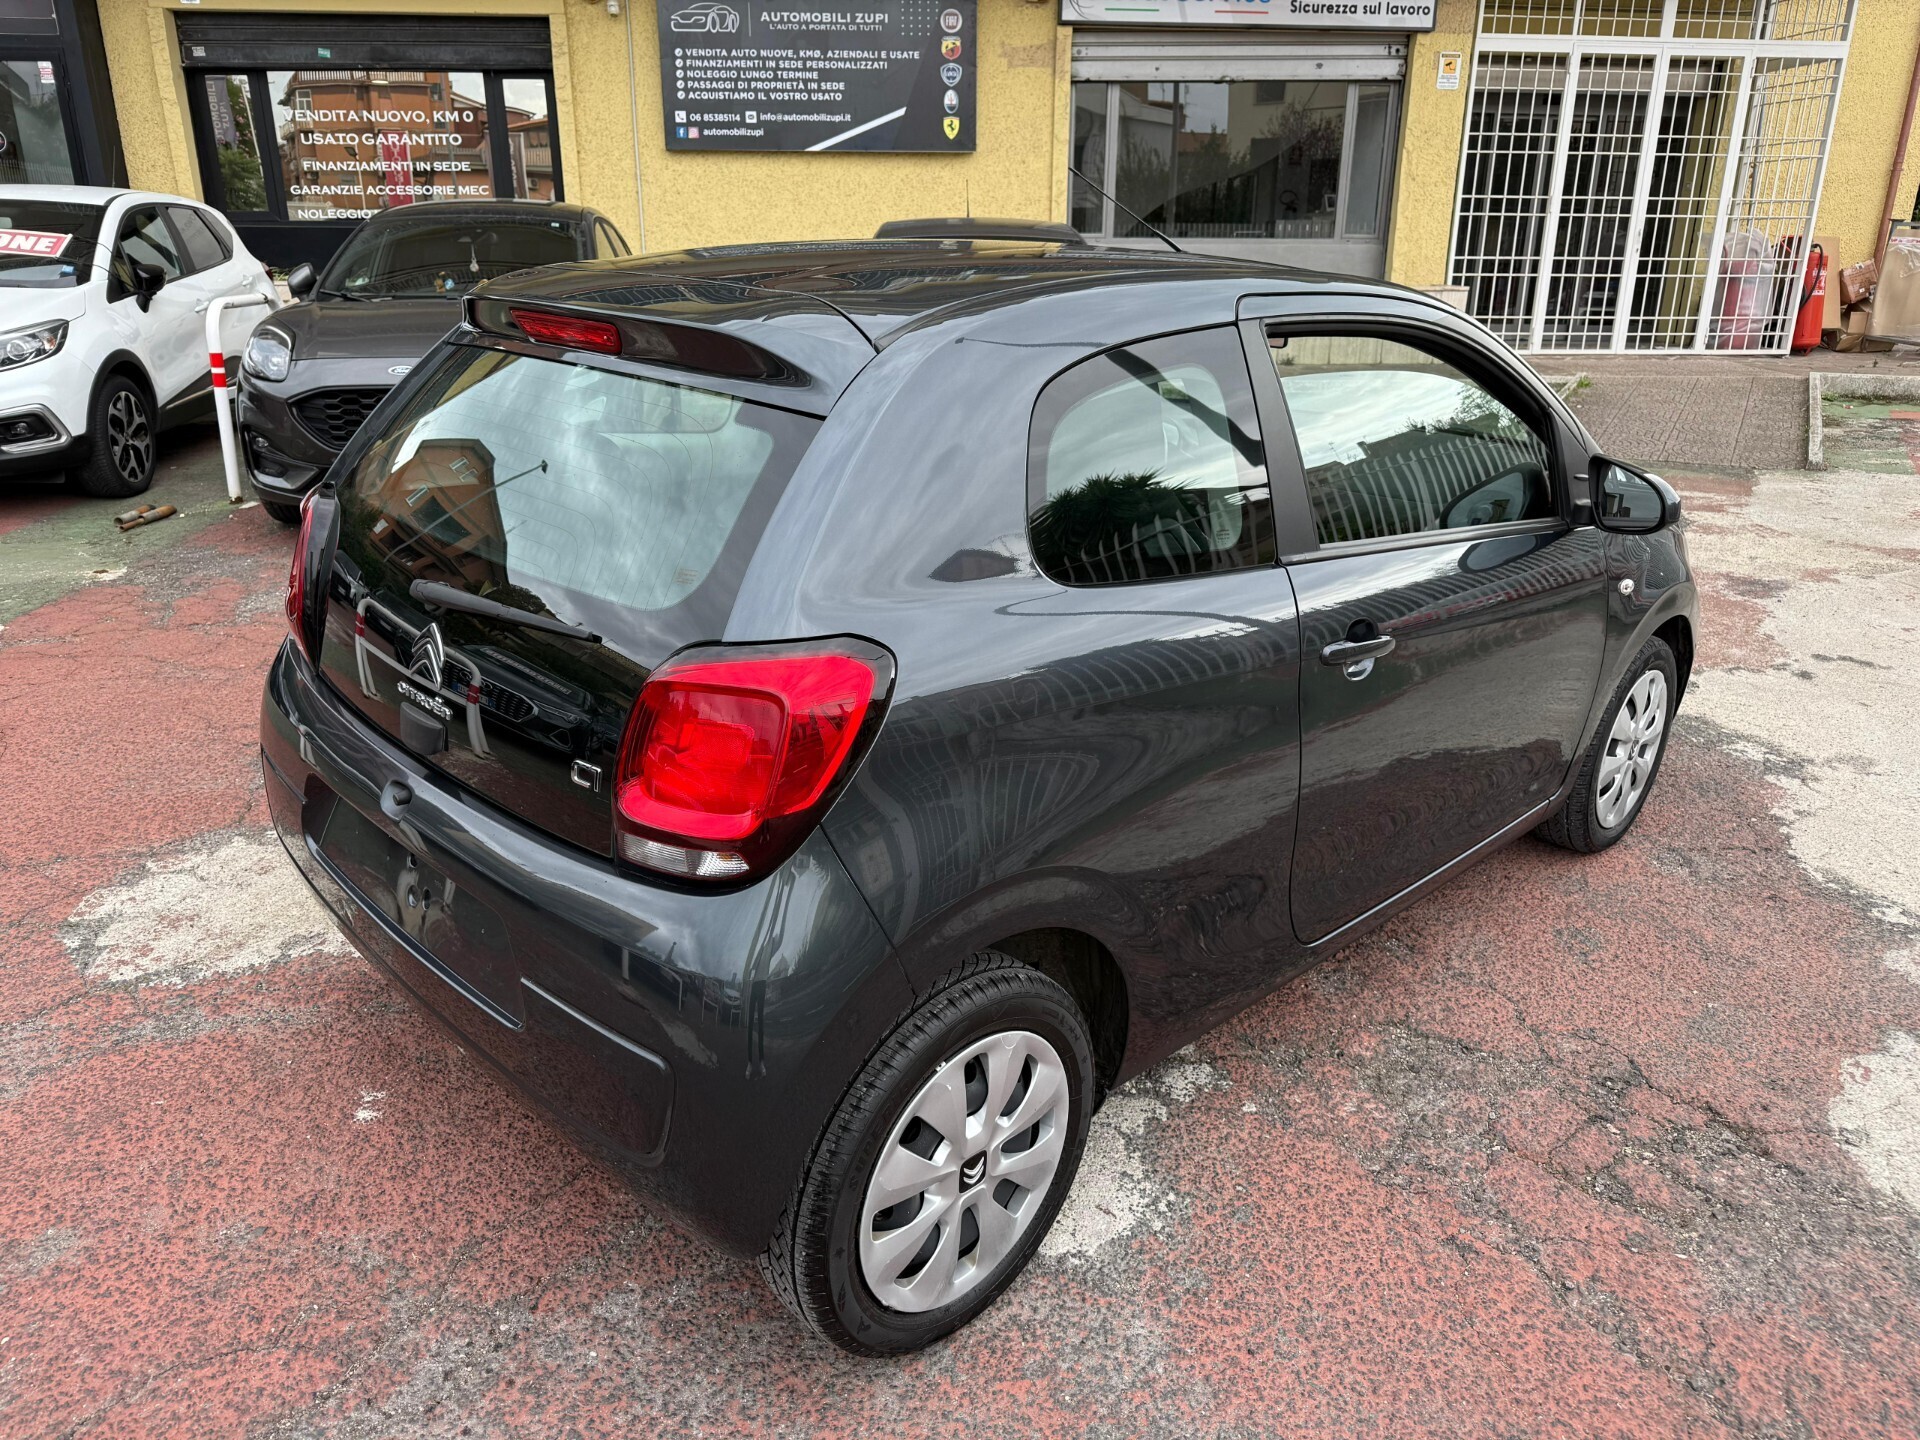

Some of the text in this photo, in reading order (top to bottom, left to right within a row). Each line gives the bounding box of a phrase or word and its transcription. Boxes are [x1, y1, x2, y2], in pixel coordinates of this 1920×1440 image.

[1290, 0, 1431, 16] Sicurezza sul lavoro
[760, 12, 889, 24] AUTOMOBILI ZUPI
[685, 49, 727, 57] VENDITA
[731, 49, 757, 57] AUTO
[760, 49, 797, 59] NUOVE,
[827, 50, 878, 59] AZIENDALI
[881, 51, 887, 59] E
[890, 51, 920, 59] USATE
[686, 60, 888, 69] FINANZIAMENTI IN SEDE PERSONALIZZATI
[687, 70, 819, 79] NOLEGGIO LUNGO TERMINE
[687, 80, 845, 90] PASSAGGI DI PROPRIETÀ IN SEDE
[688, 91, 843, 101] ACQUISTIAMO IL VOSTRO USATO
[219, 101, 230, 129] ZUPI
[283, 110, 474, 125] VENDITA NUOVO, KM 0
[689, 113, 741, 122] 06 85385114
[760, 112, 852, 123] info@automobilizupi.it
[703, 128, 764, 137] automobilizupi
[300, 133, 462, 146] USATO GARANTITO
[303, 161, 471, 172] FINANZIAMENTI IN SEDE
[290, 185, 489, 196] GARANZIE ACCESSORIE MEC
[297, 209, 372, 219] NOLEGGIO
[397, 681, 453, 721] CITROËN
[570, 759, 602, 793] C1
